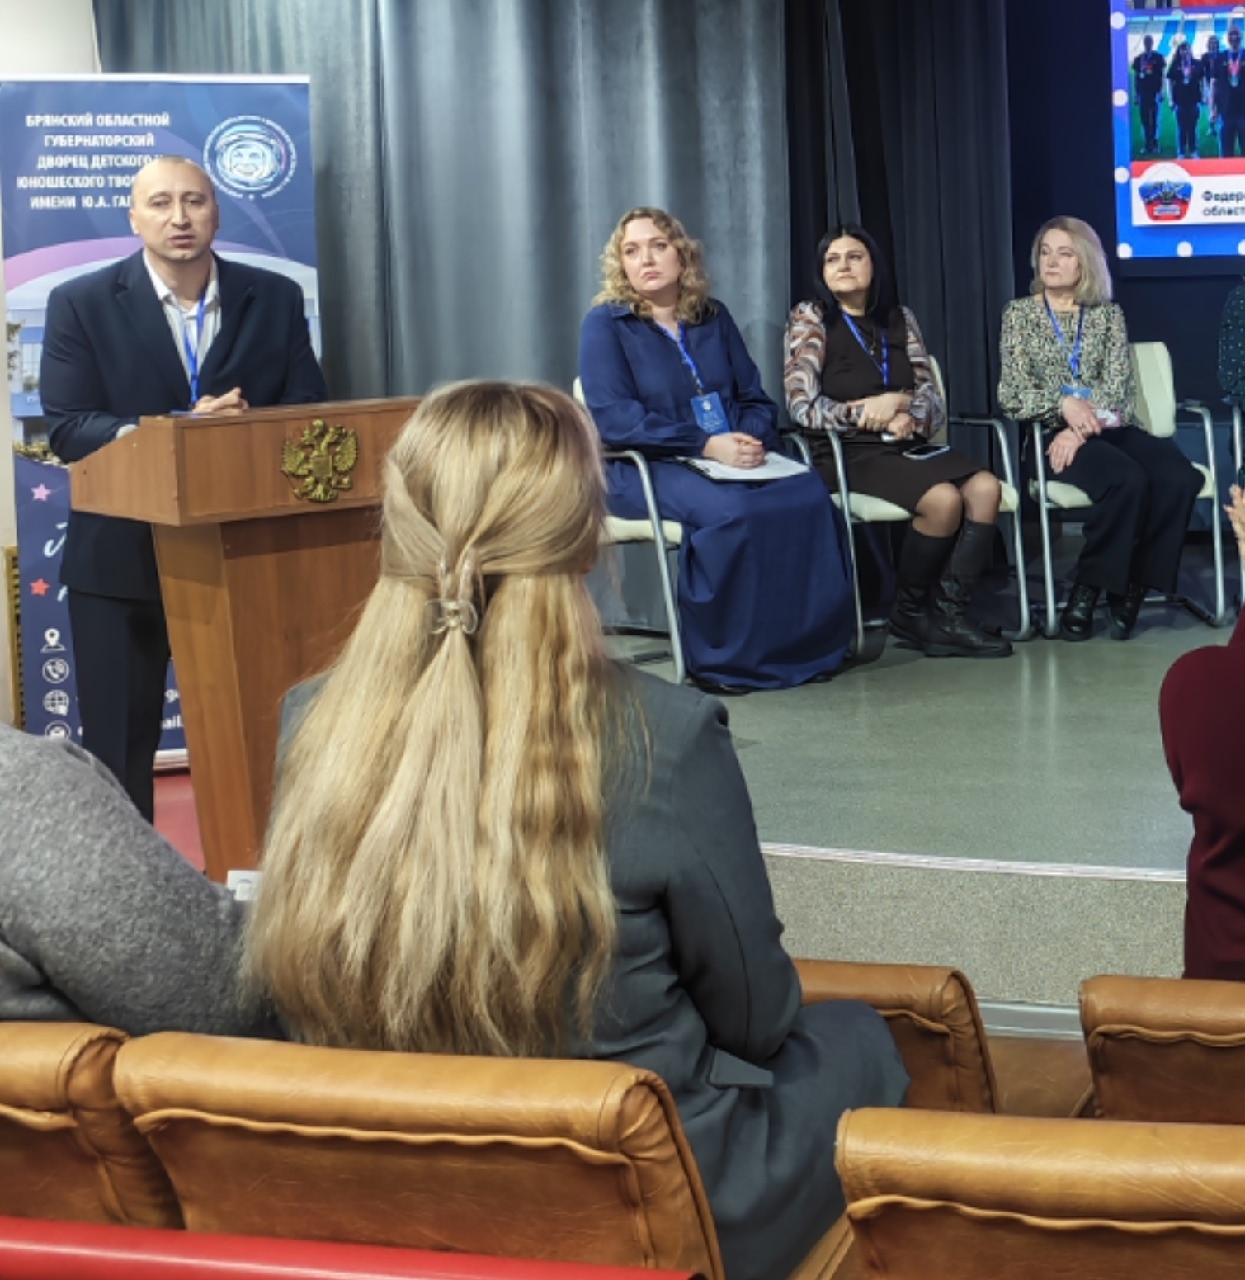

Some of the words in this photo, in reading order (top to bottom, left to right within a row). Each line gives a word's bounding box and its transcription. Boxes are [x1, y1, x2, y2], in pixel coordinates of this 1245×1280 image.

[25, 111, 93, 127] БРЯНСКИЙ
[96, 111, 170, 127] ОБЛАСТНОЙ
[44, 132, 155, 147] ГУБЕРНАТОРСКИЙ
[36, 154, 89, 170] ДВОРЕЦ
[90, 154, 152, 169] ДЕТСКОГО
[16, 176, 106, 189] ЮНОШЕСКОГО
[30, 195, 77, 210] ИМЕНИ
[81, 195, 110, 208] Ю.А.
